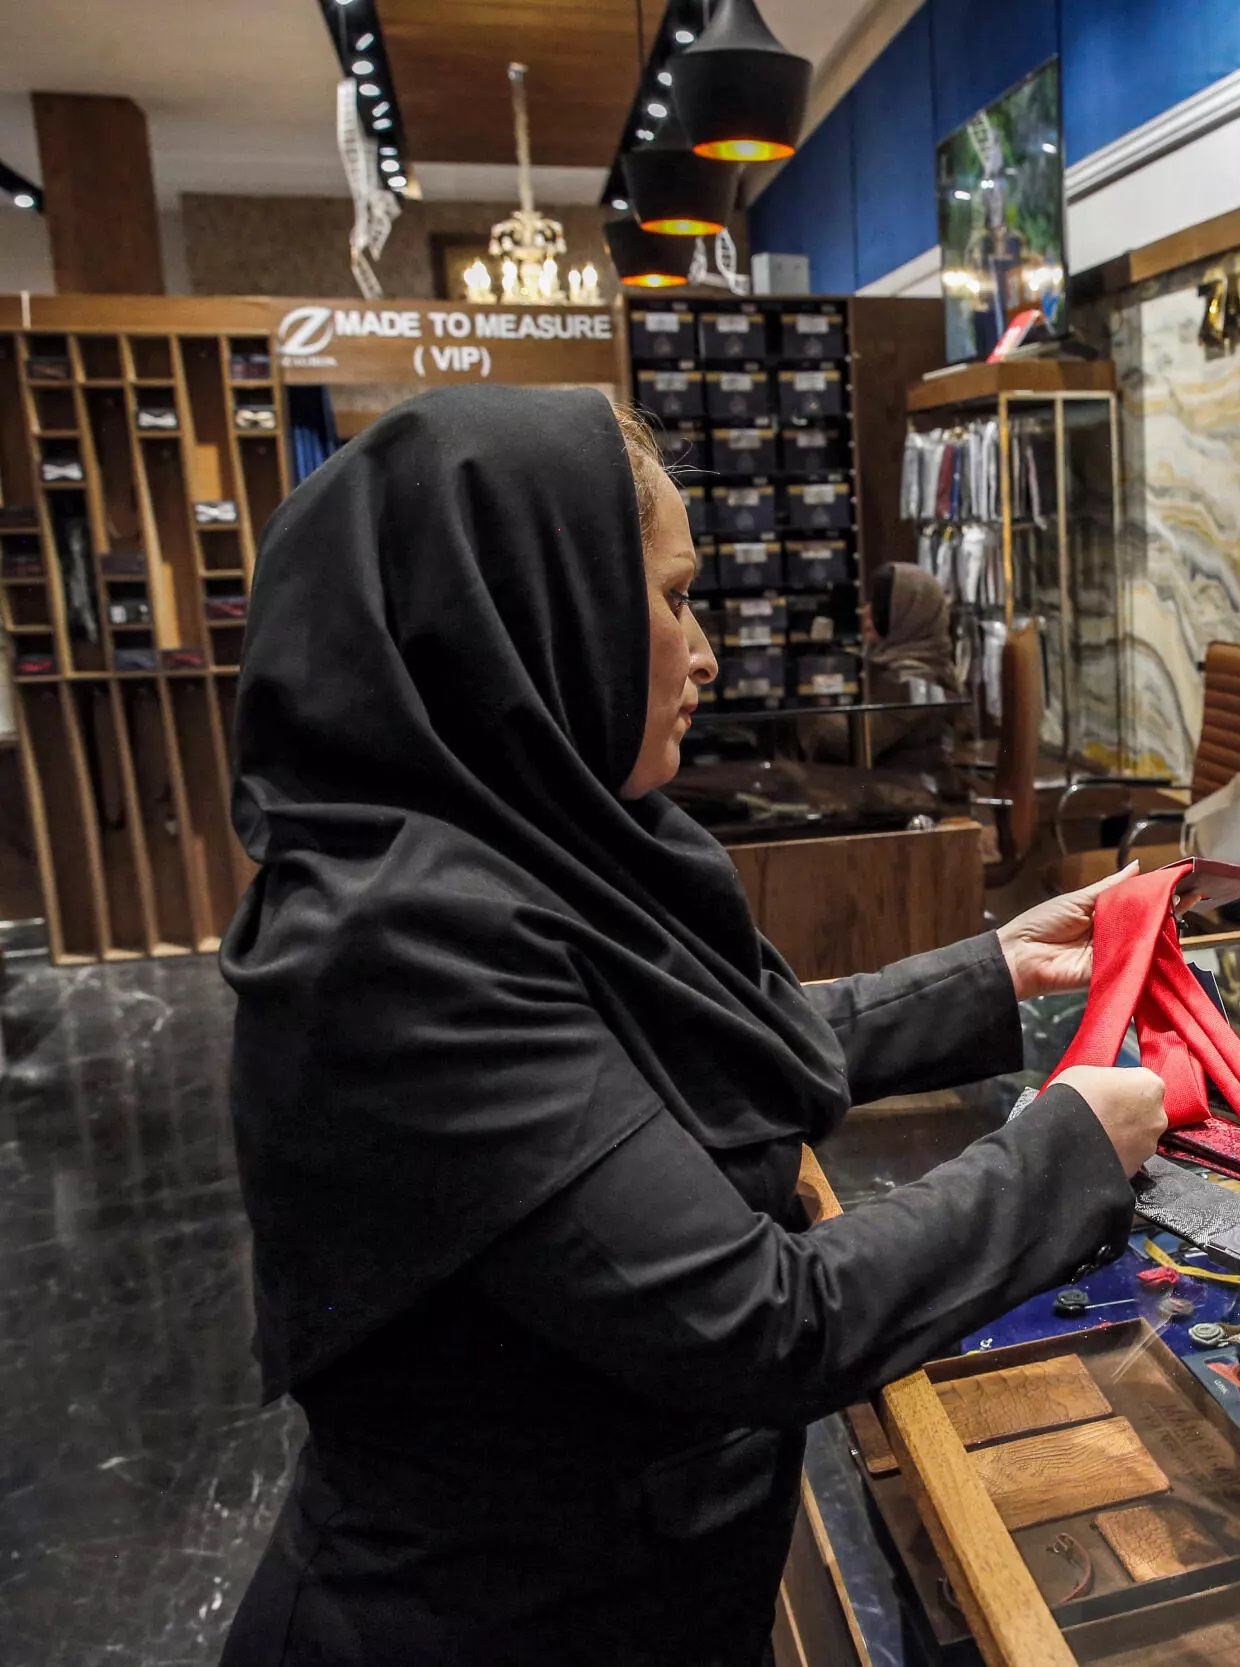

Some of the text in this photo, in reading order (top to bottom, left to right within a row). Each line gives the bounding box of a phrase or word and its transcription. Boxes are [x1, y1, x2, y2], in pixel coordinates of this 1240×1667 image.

[334, 310, 612, 340] MADE TO MEASURE
[413, 344, 492, 378] (VIP)
